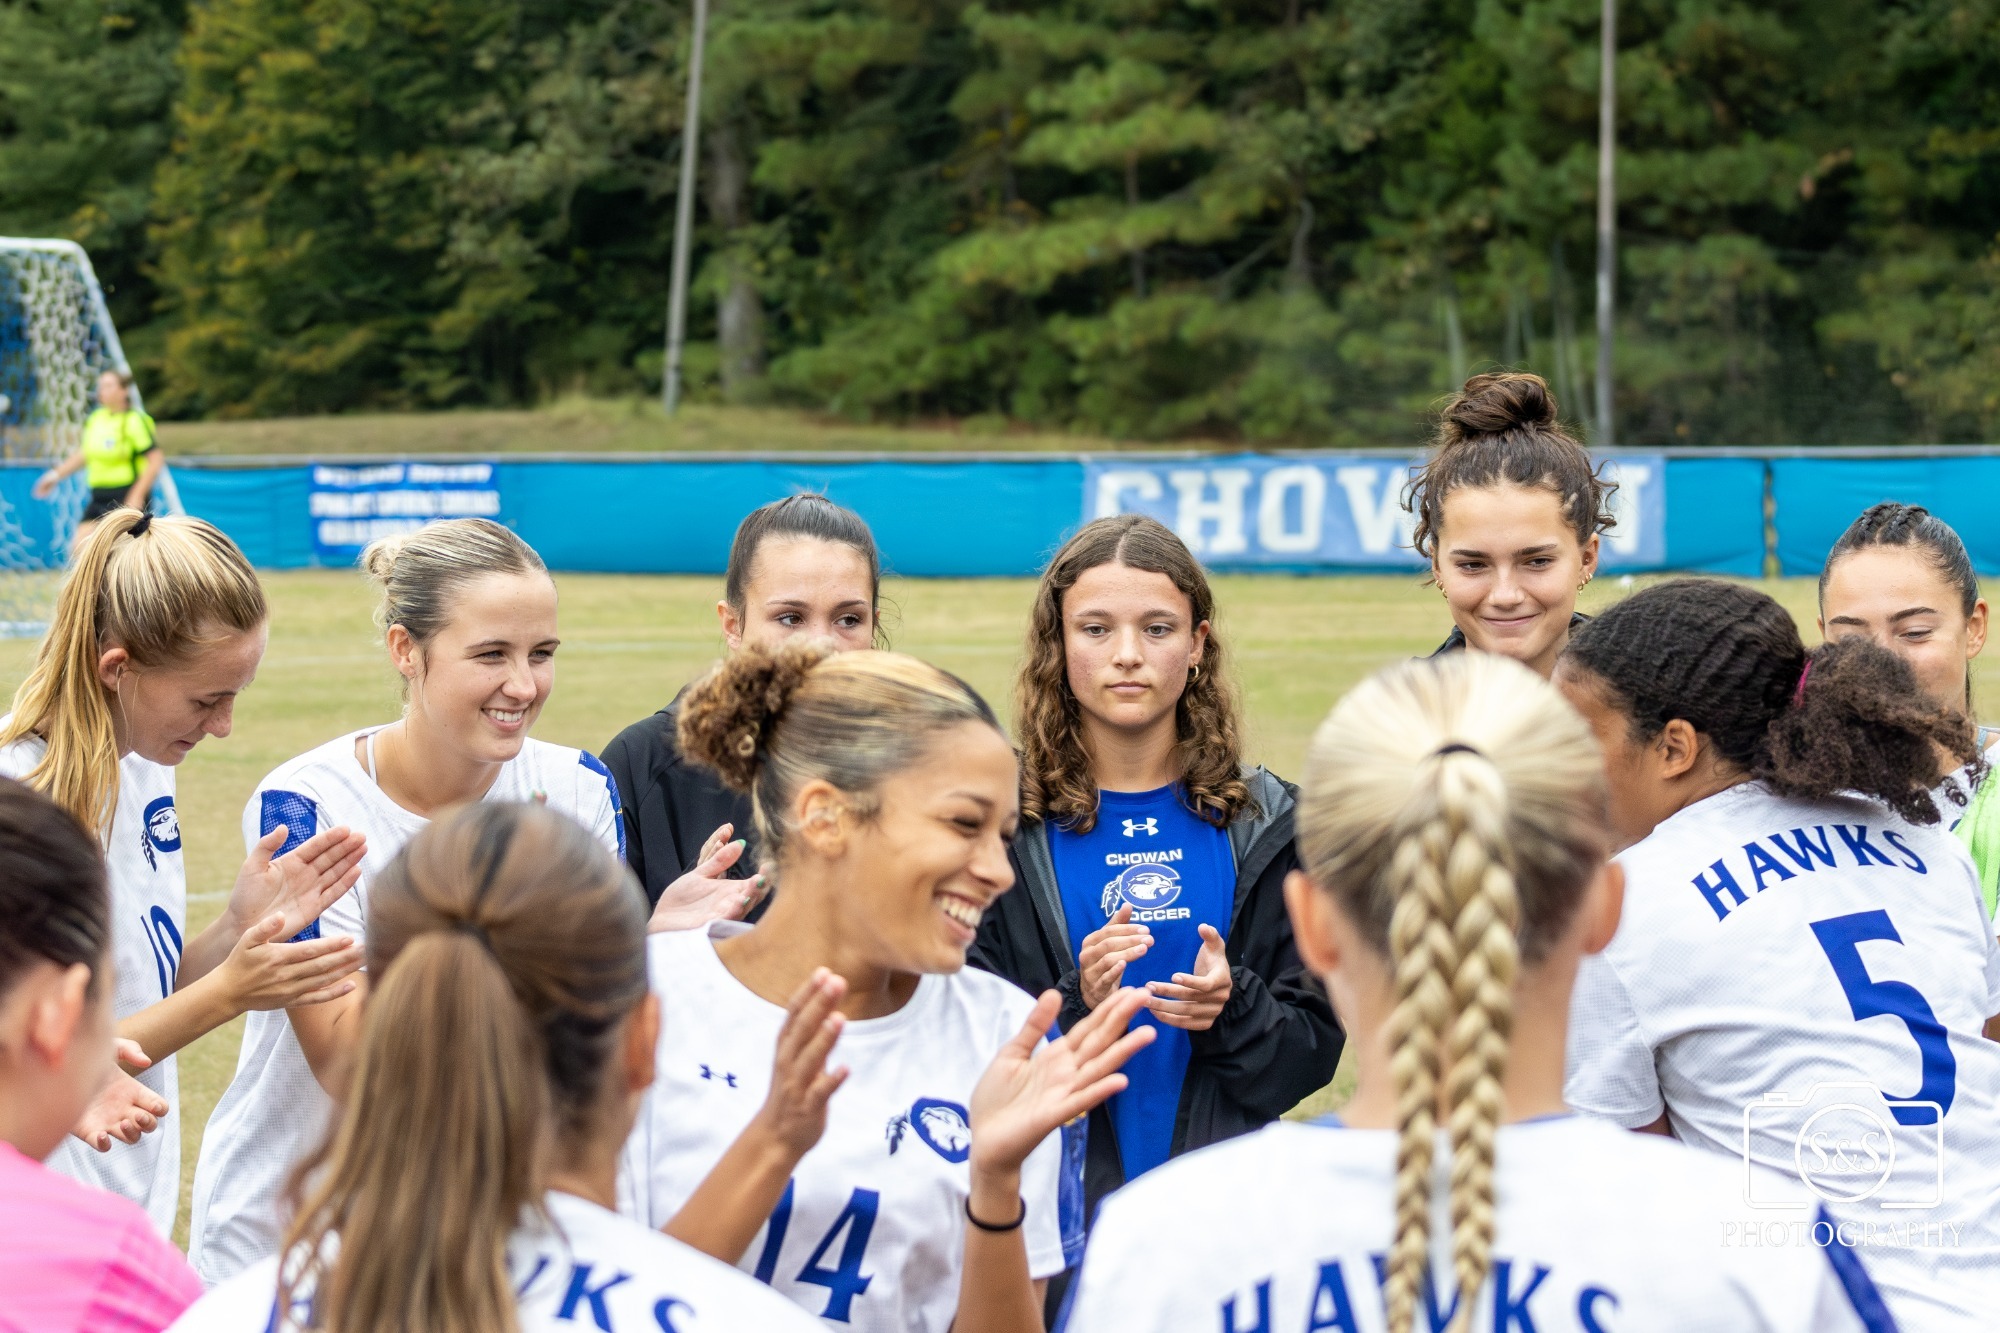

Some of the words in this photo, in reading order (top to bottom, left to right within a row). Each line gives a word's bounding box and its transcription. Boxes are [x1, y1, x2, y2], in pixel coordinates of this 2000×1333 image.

[1095, 466, 1652, 555] CHOW
[1105, 849, 1183, 866] CHOWAN
[1691, 824, 1928, 923] HAWKS
[1114, 907, 1191, 922] OCCER
[1808, 908, 1957, 1126] 5
[754, 1176, 880, 1323] 14
